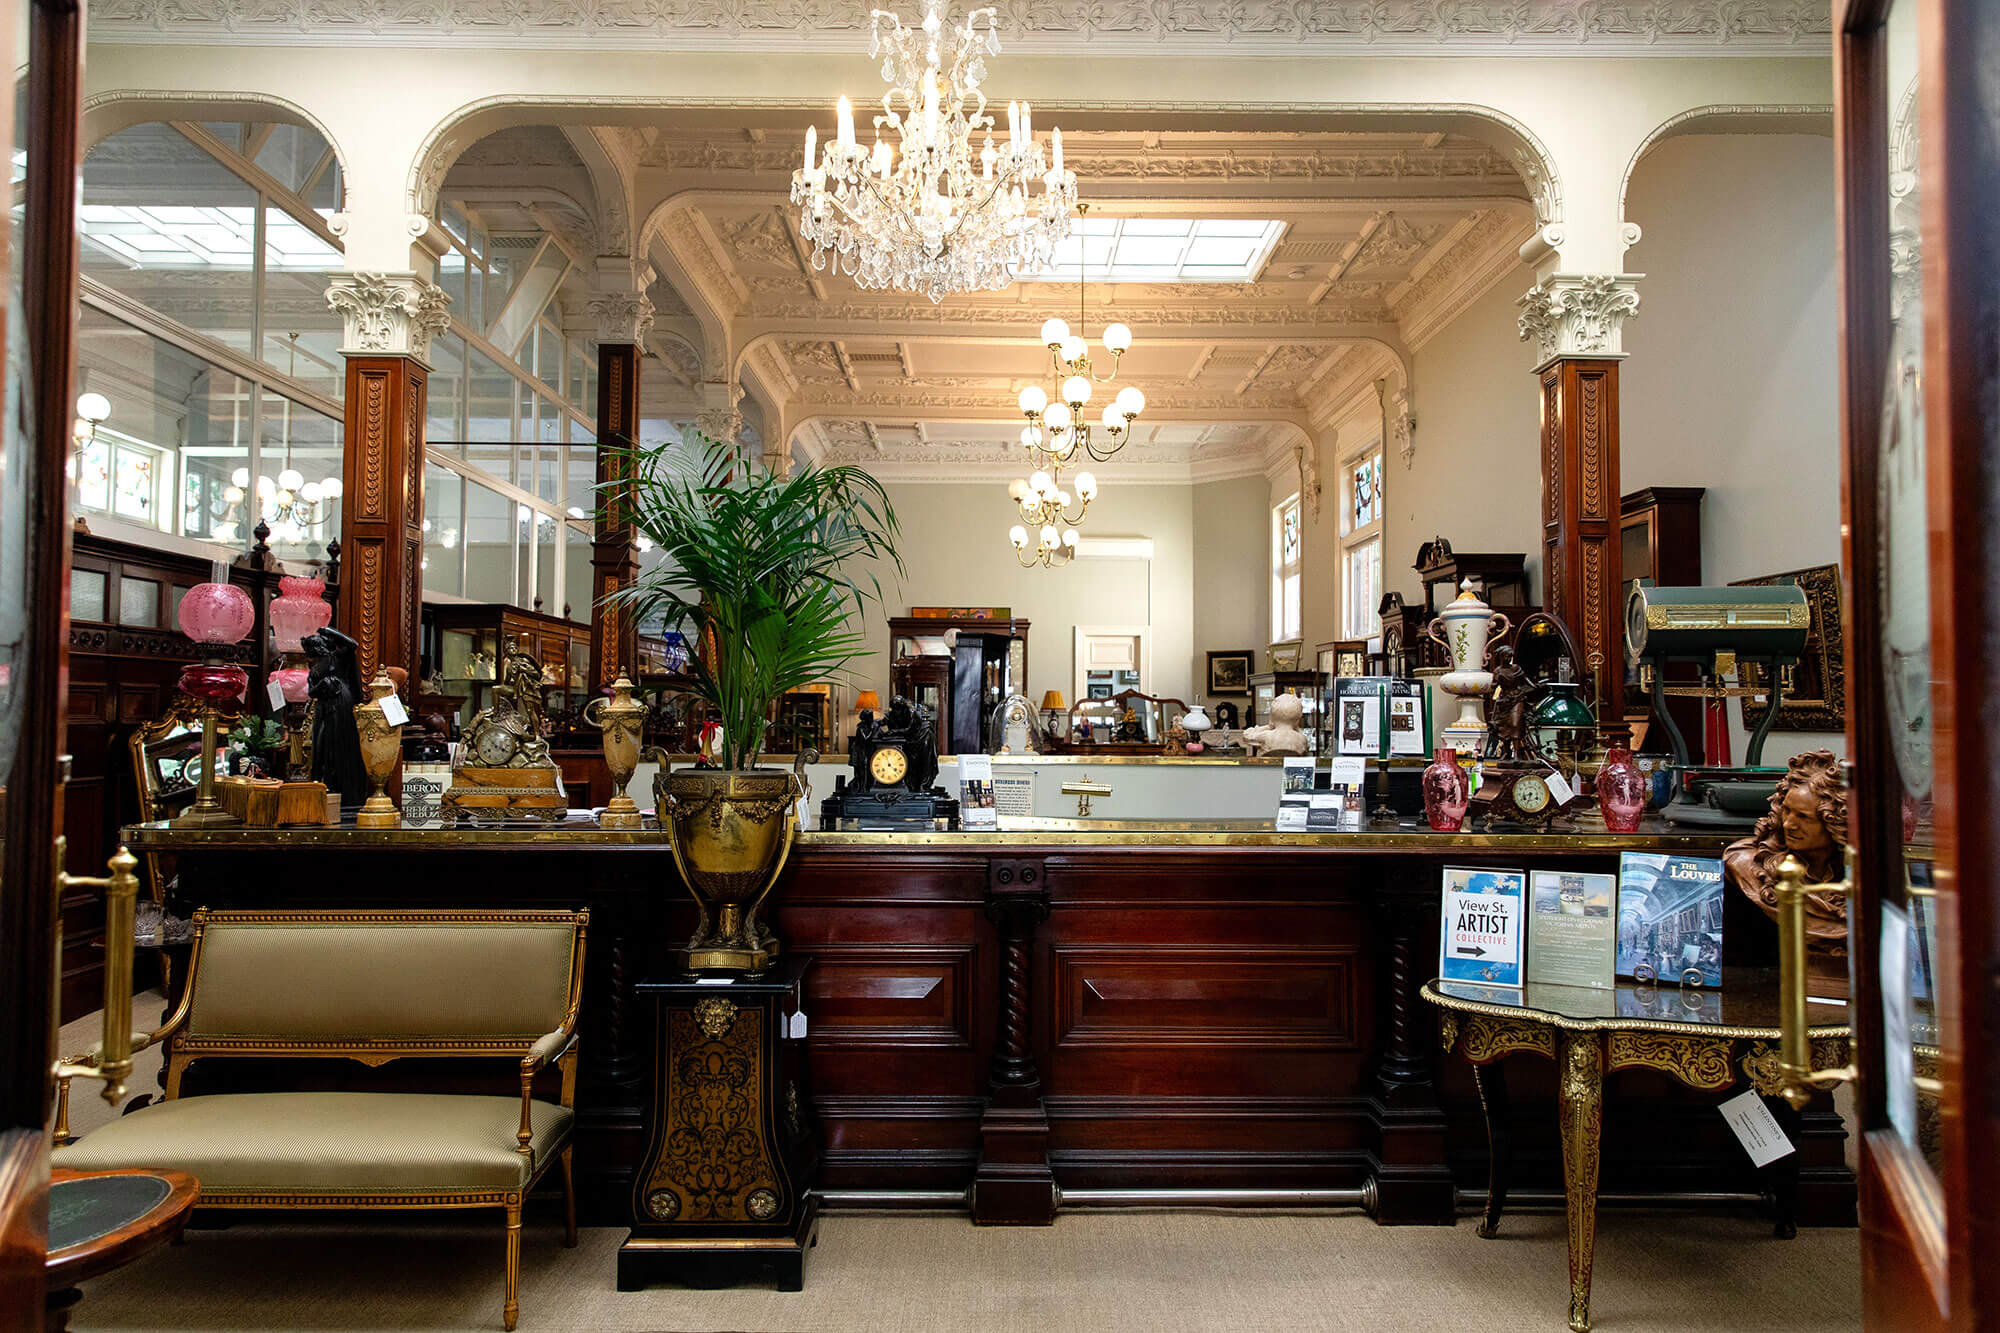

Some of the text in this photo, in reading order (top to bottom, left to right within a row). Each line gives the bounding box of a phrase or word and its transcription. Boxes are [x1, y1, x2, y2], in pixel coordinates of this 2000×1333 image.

[402, 784, 441, 793] IBERON
[1680, 862, 1697, 871] THE
[1670, 865, 1721, 882] LOUVRE
[1459, 899, 1508, 914] View St.
[1457, 912, 1509, 935] ARTIST
[1456, 933, 1507, 945] COLLECTIVE
